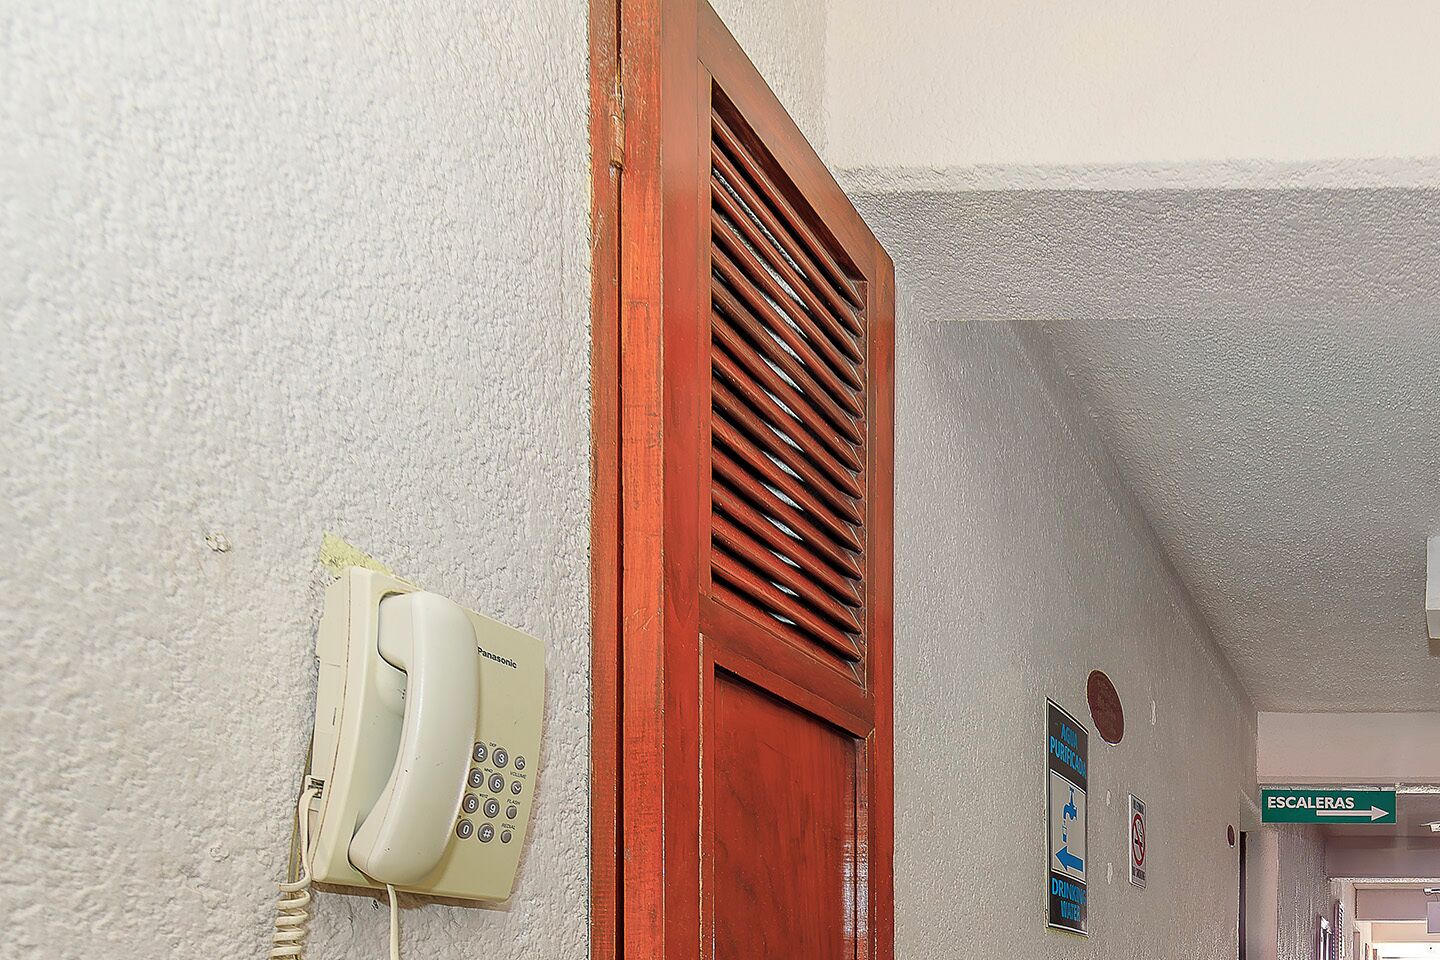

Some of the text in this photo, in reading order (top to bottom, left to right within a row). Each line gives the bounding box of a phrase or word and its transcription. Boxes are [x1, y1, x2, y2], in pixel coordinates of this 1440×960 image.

[477, 646, 517, 669] Panasonic
[478, 747, 484, 758] 2
[498, 753, 505, 763] 3
[473, 773, 480, 784] 5
[494, 778, 501, 789] 6
[468, 799, 475, 809] 8
[489, 803, 496, 813] 9
[1267, 796, 1355, 809] ESCALERAS
[463, 824, 470, 834] 0
[1052, 877, 1086, 905] DRINKING
[1061, 900, 1081, 922] WATER
